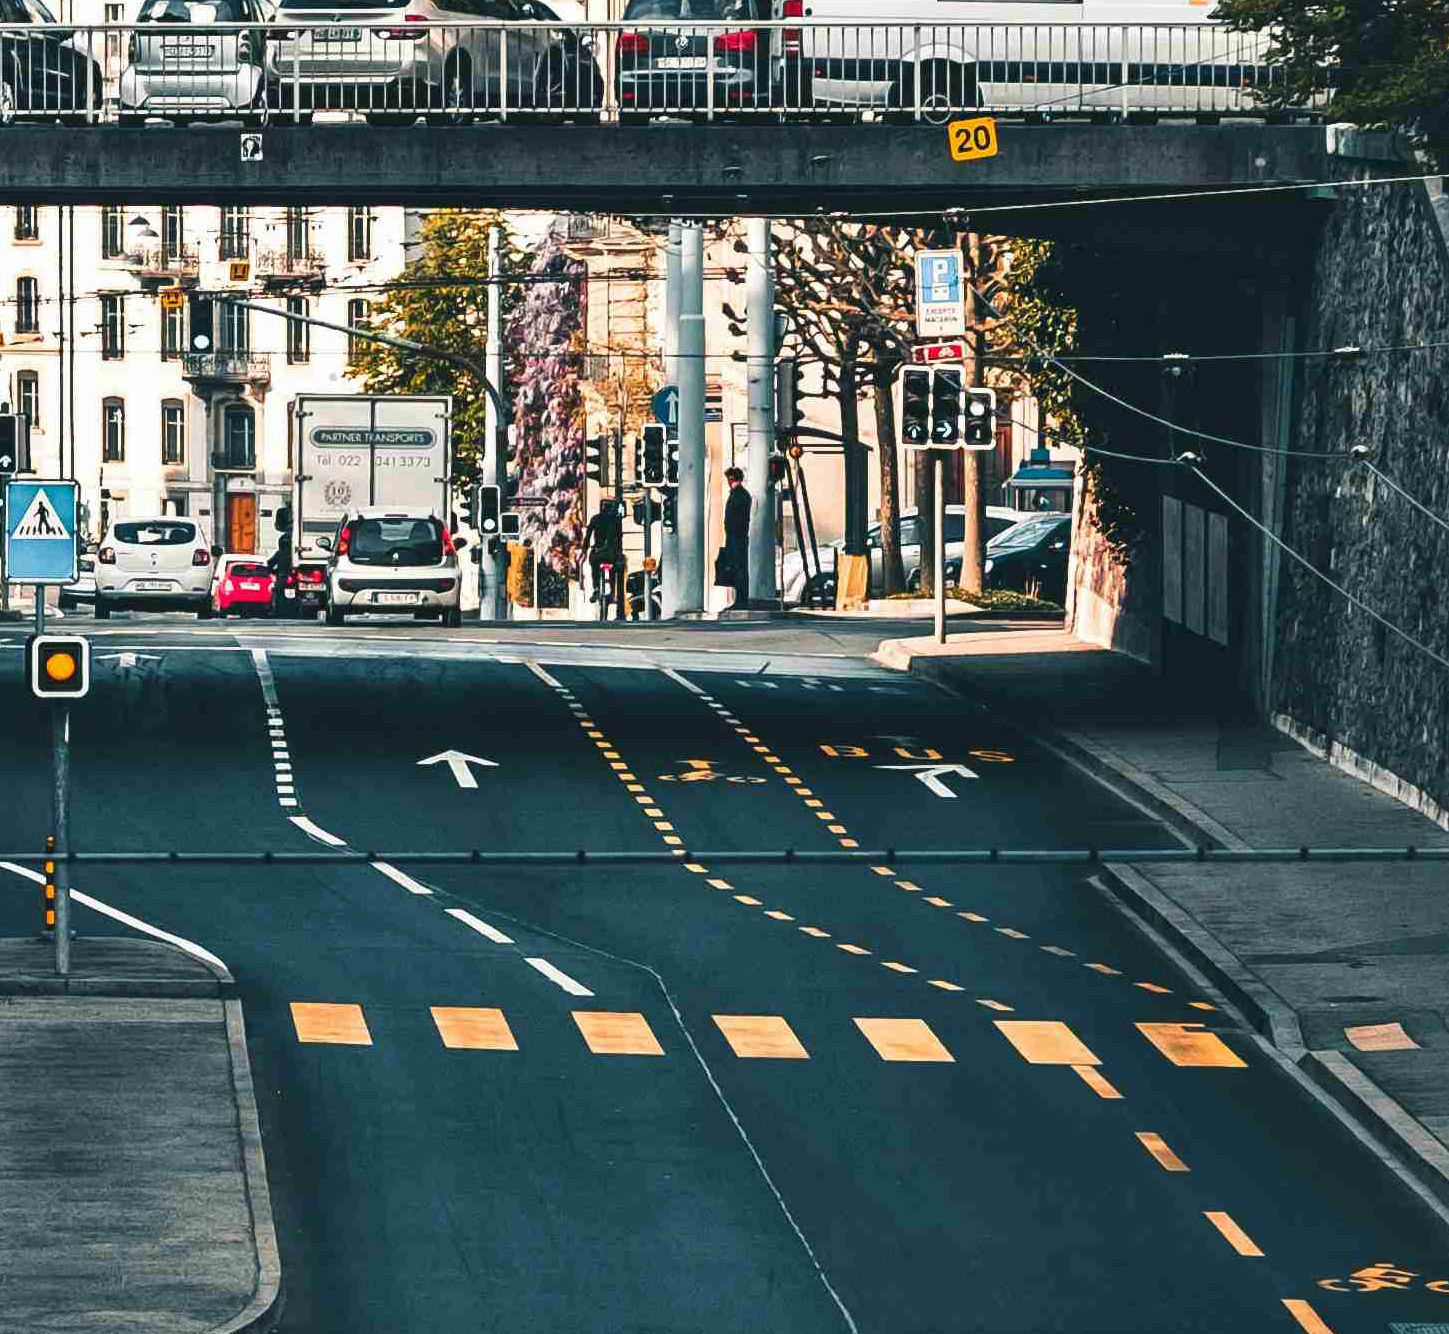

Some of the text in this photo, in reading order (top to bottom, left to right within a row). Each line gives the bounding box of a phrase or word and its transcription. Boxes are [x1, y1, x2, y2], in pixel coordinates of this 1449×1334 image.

[955, 125, 991, 153] 20
[932, 259, 949, 283] P
[320, 432, 425, 444] PARTNER TRANSPORTS
[819, 744, 1015, 763] BUS
